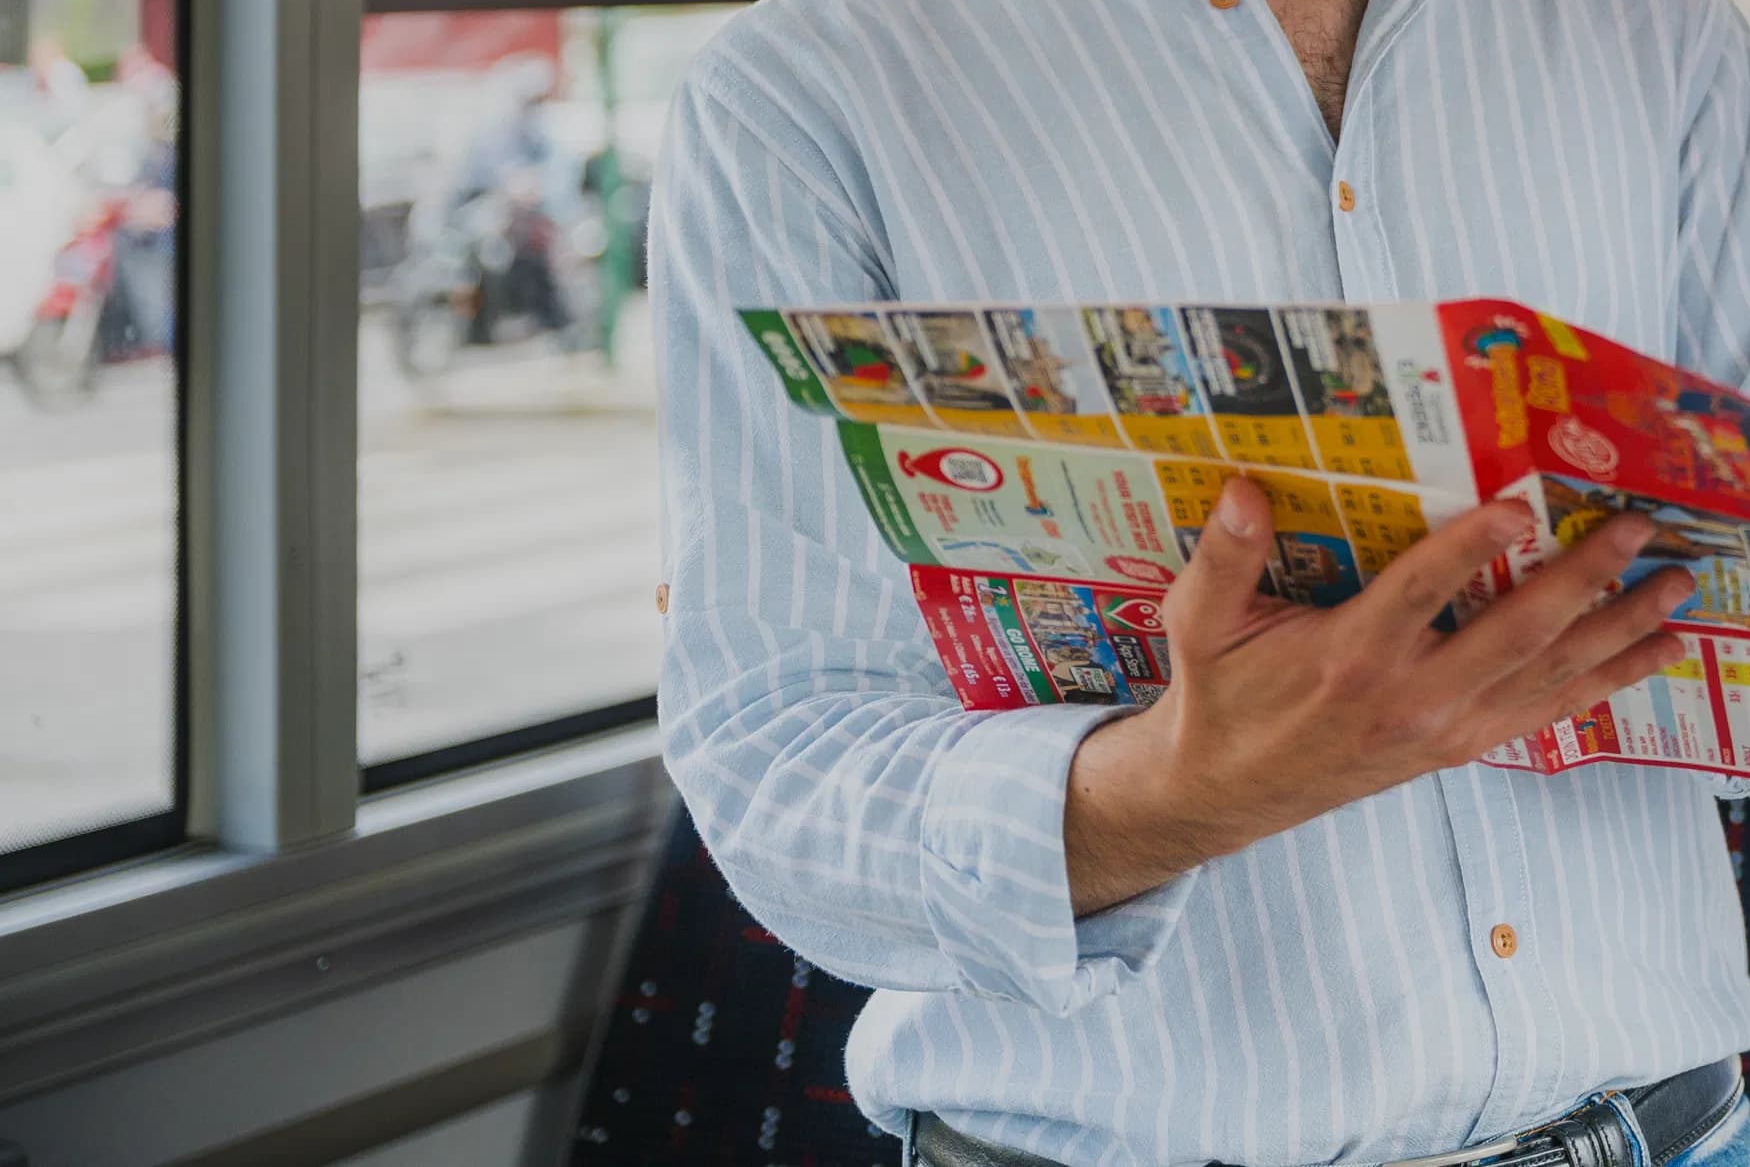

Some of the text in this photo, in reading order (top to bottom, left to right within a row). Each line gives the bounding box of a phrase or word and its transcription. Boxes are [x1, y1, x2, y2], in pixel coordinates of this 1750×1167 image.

[1007, 629, 1040, 672] GO ROME
[1601, 714, 1615, 740] TICKETS
